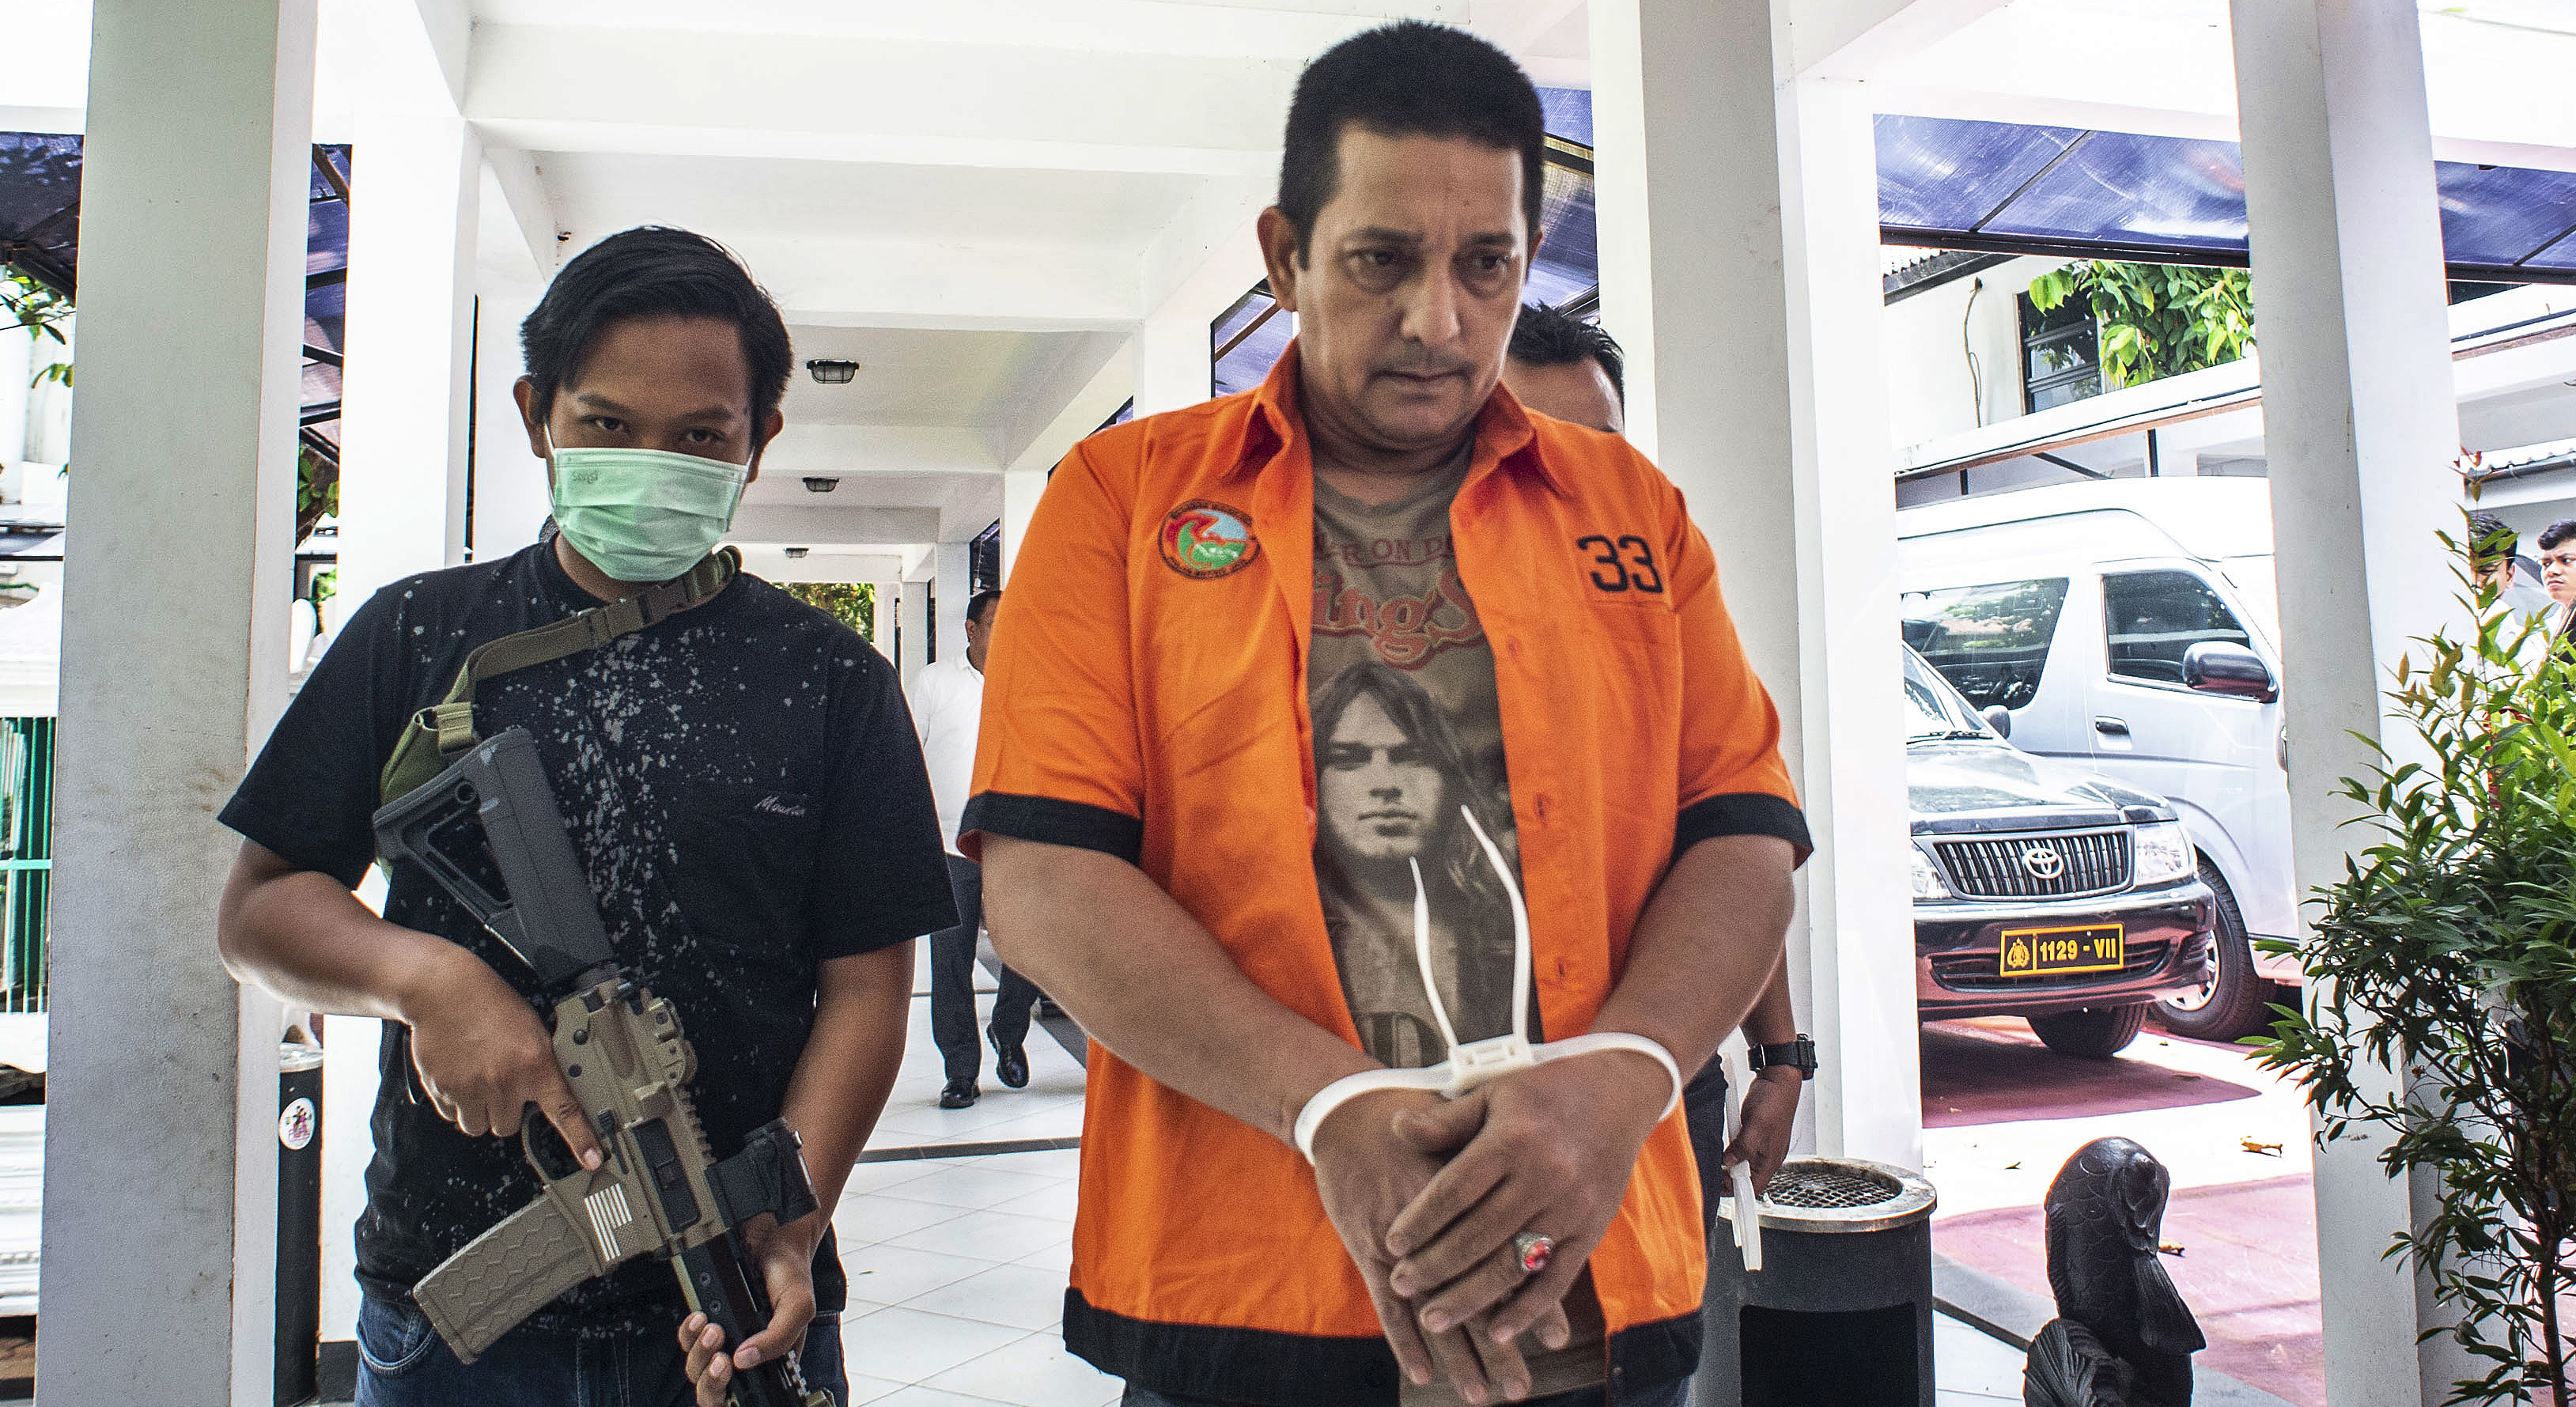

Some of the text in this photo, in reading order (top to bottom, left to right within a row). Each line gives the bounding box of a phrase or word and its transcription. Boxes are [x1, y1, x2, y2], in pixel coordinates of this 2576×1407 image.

[1372, 538, 1411, 562] ON
[1576, 535, 1663, 593] 33
[2040, 940, 2079, 962] 1129
[2094, 938, 2116, 959] VII
